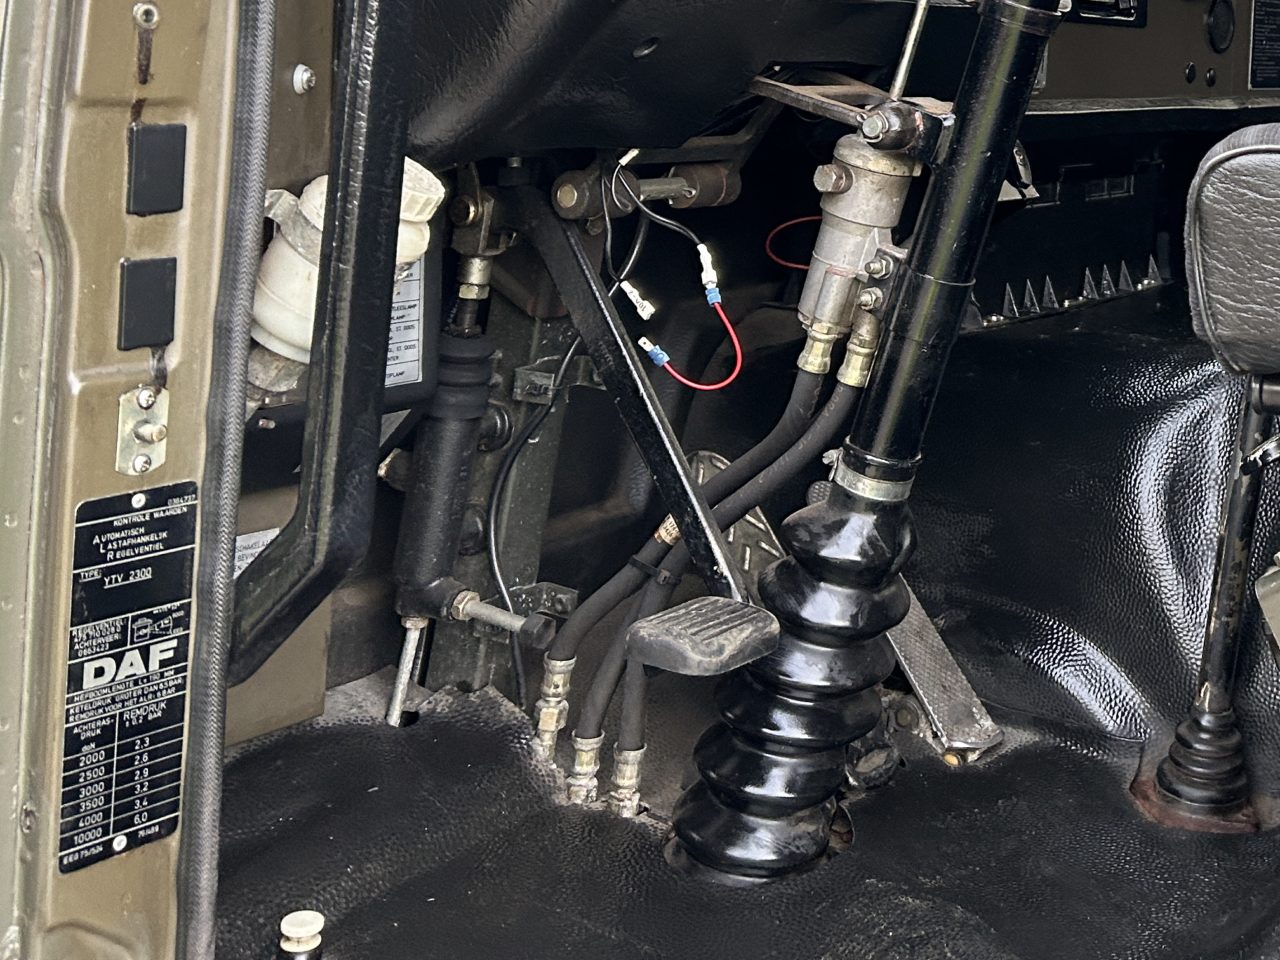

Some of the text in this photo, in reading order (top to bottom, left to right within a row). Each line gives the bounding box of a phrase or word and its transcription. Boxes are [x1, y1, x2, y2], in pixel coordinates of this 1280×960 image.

[113, 506, 187, 527] KONTROLE WAARDEN
[103, 567, 152, 587] YTV 2300
[82, 638, 178, 690] DAF
[69, 698, 112, 715] KETELDRUK
[115, 687, 142, 702] GROTER
[143, 684, 158, 695] DAN
[69, 707, 105, 723] REMDRUK
[103, 701, 122, 715] VOOR
[124, 696, 138, 708] HET
[161, 687, 175, 698] BAR
[123, 700, 167, 721] REMDRUK
[147, 710, 163, 721] BAR
[80, 727, 102, 741] DRUK
[79, 749, 106, 767] 2000
[78, 766, 105, 783] 2500
[78, 781, 105, 799] 3000
[79, 795, 105, 812] 3500
[78, 811, 104, 828] 4000
[73, 827, 103, 846] 10000
